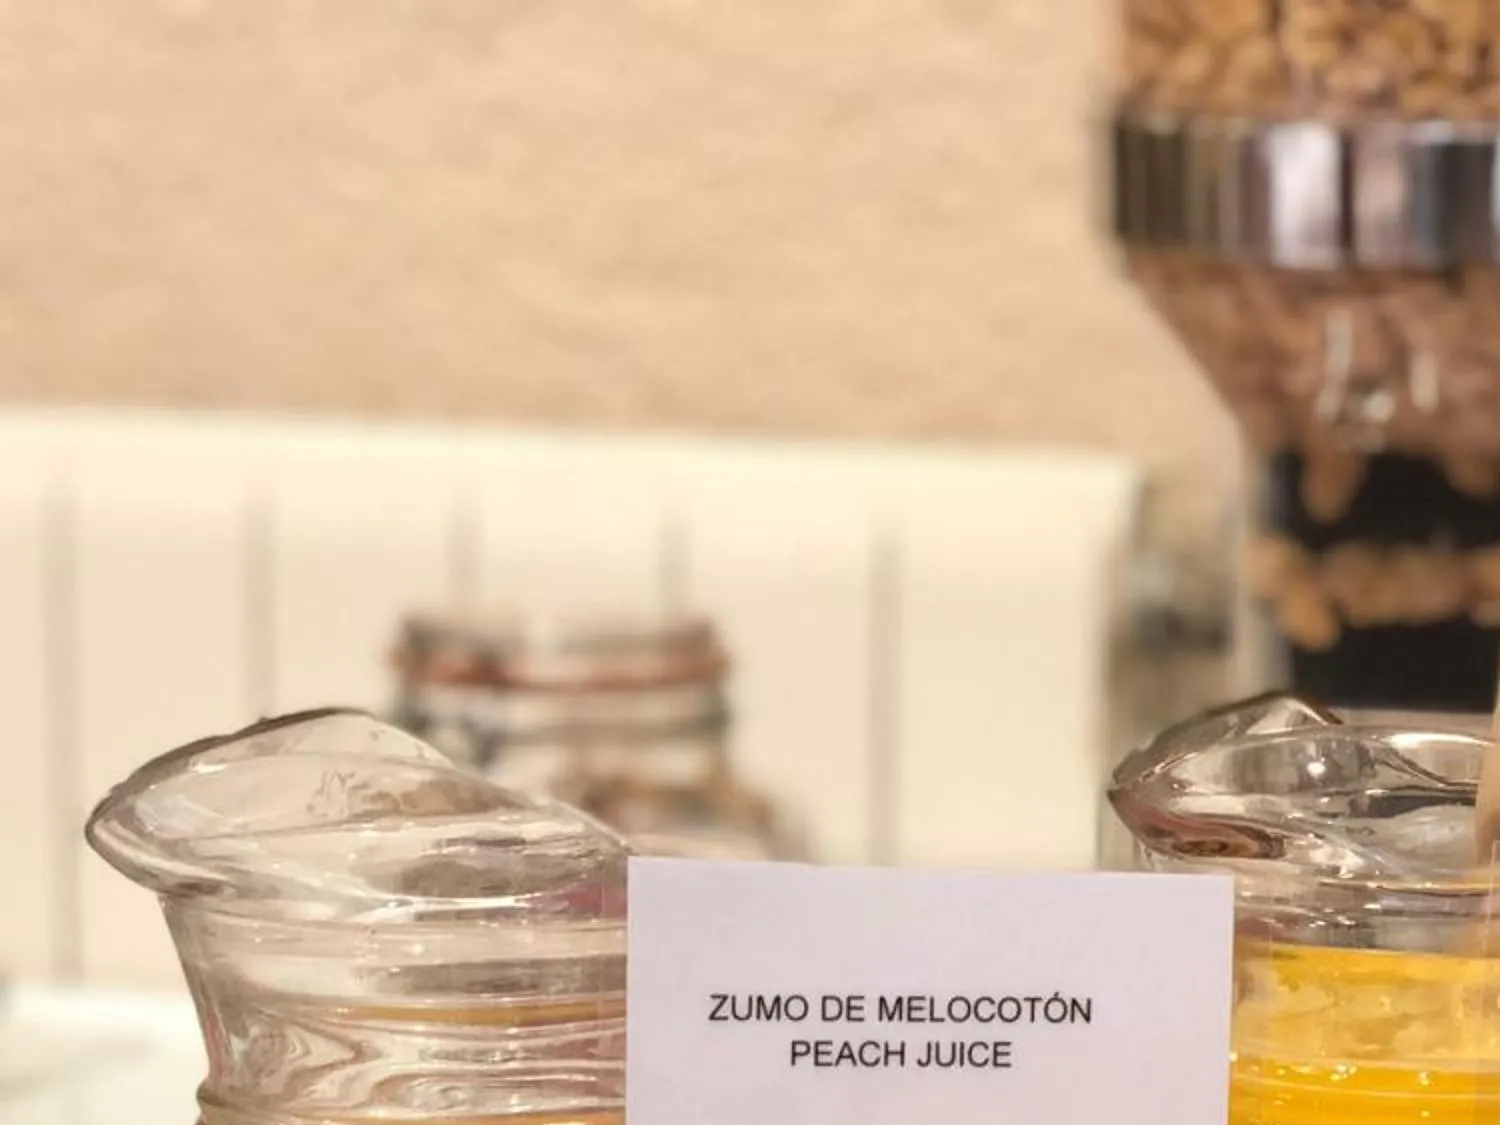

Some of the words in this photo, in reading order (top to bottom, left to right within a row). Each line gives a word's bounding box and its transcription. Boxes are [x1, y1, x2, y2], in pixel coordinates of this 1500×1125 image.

[708, 993, 809, 1023] ZUMO
[821, 994, 865, 1023] DE
[878, 991, 1092, 1024] MELOCOTÓN
[791, 1040, 905, 1068] PEACH
[916, 1041, 1012, 1068] JUICE
